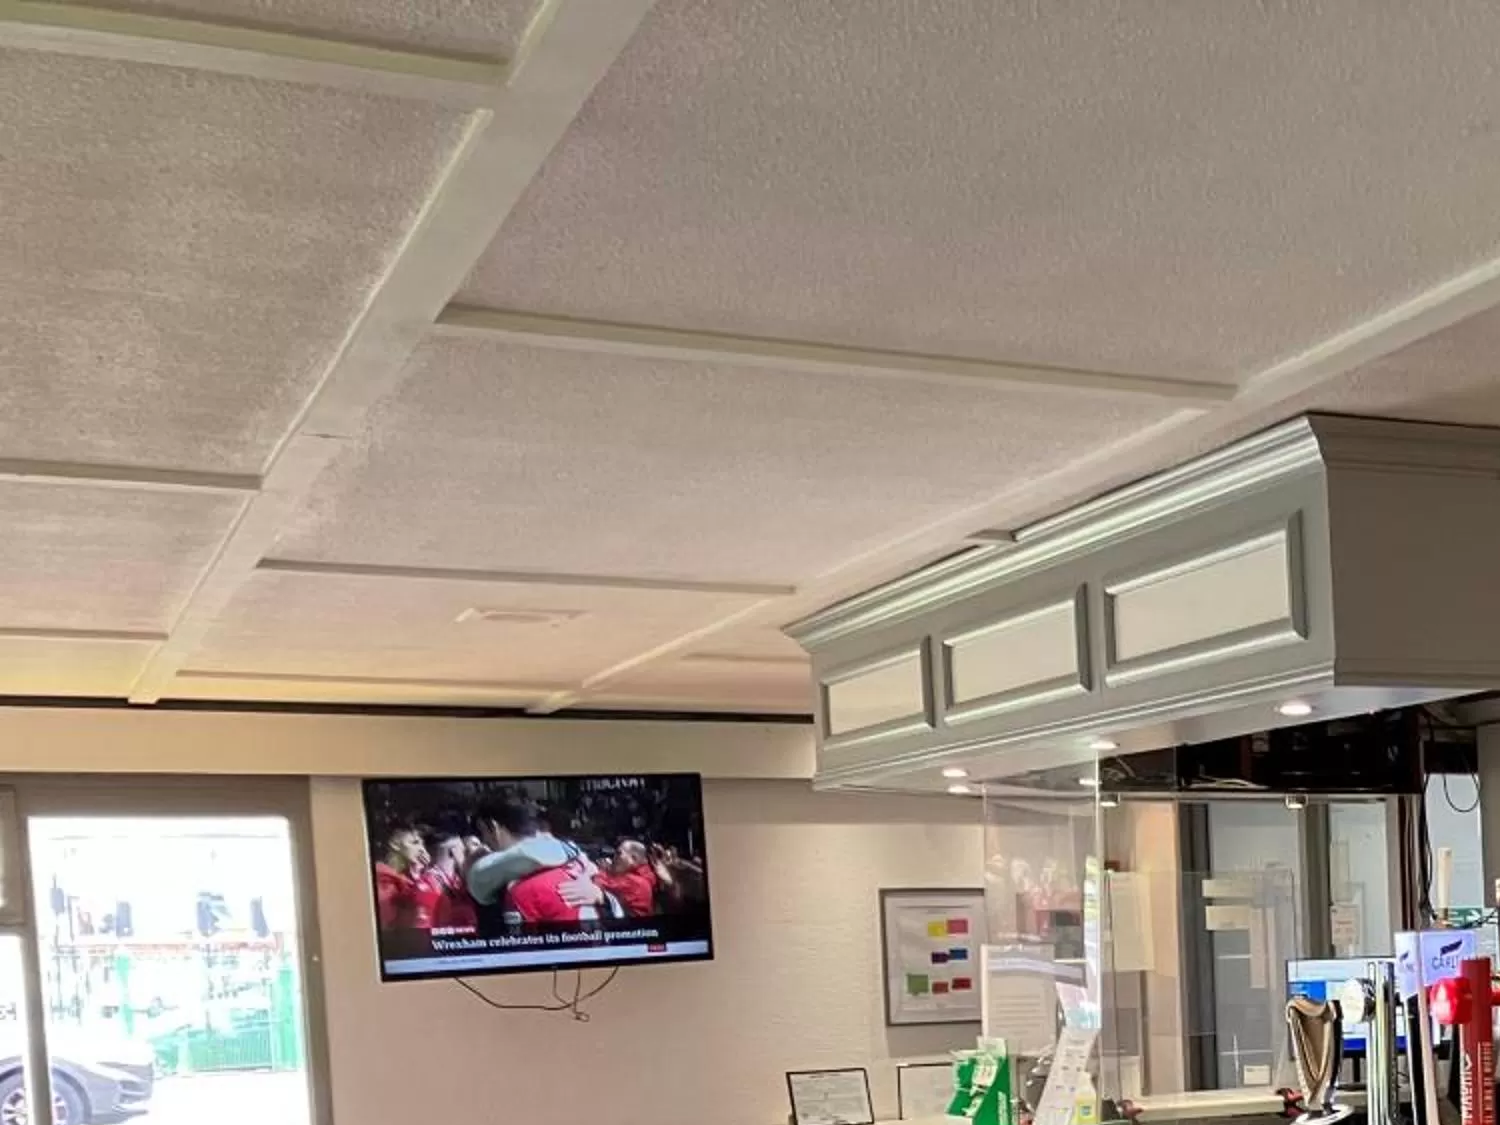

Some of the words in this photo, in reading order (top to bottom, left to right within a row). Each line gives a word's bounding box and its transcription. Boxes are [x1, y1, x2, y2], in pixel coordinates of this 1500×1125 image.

[432, 938, 487, 950] Wrexham
[489, 935, 544, 947] celebrates
[545, 933, 560, 943] its
[561, 930, 602, 942] football
[604, 928, 659, 943] promotion
